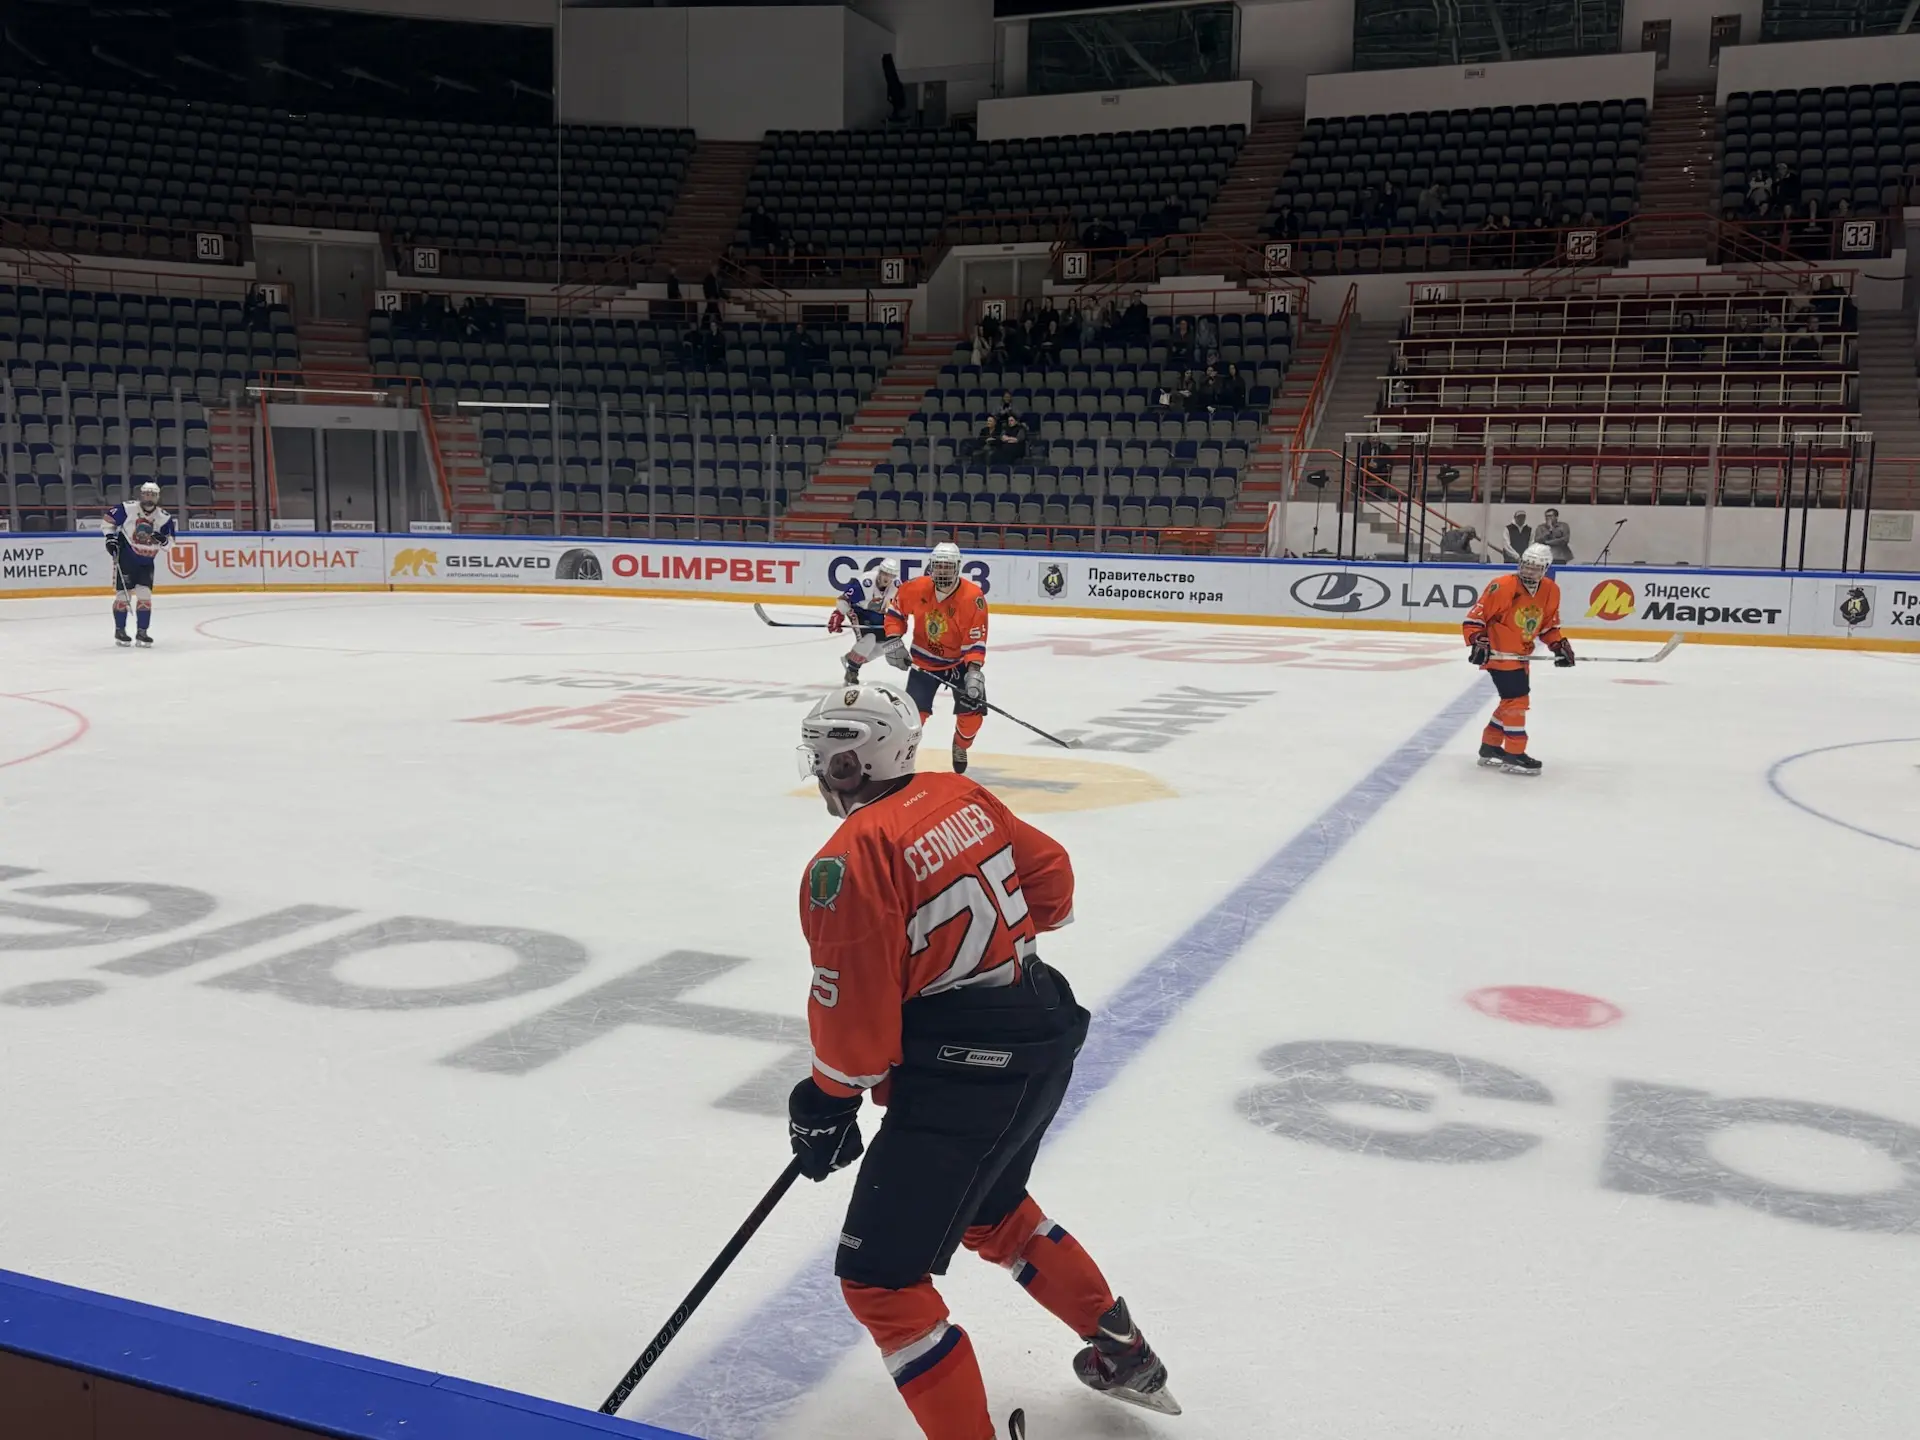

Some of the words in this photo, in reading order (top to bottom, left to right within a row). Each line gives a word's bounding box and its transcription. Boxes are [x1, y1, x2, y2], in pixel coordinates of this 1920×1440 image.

[1571, 236, 1593, 256] 32
[1847, 226, 1871, 247] 33
[200, 237, 221, 256] 30
[417, 251, 437, 269] 30
[1067, 256, 1085, 275] 31
[885, 262, 901, 280] 31
[380, 295, 397, 311] 12
[882, 307, 898, 323] 12
[2, 548, 44, 562] АМУР
[205, 549, 359, 568] ЧЕМПИОНАТ
[445, 555, 550, 569] GISLAVED
[4, 563, 88, 579] МИНЕРАЛС
[612, 553, 800, 584] OLIMPBET
[1088, 567, 1195, 584] Правительство
[1087, 585, 1185, 602] Хабаровского
[1189, 590, 1223, 604] края
[1401, 583, 1478, 608] LAD
[1644, 582, 1710, 600] Яндекс
[1893, 591, 1920, 609] Пр
[1641, 602, 1782, 626] Маркет
[1028, 685, 1278, 754] БАНК
[903, 803, 995, 882] СЕЛИЩЕВ
[906, 842, 1038, 998] 25
[0, 864, 812, 1115] Haie
[788, 1119, 837, 1137] CM
[600, 1304, 689, 1416] R-WOOD
